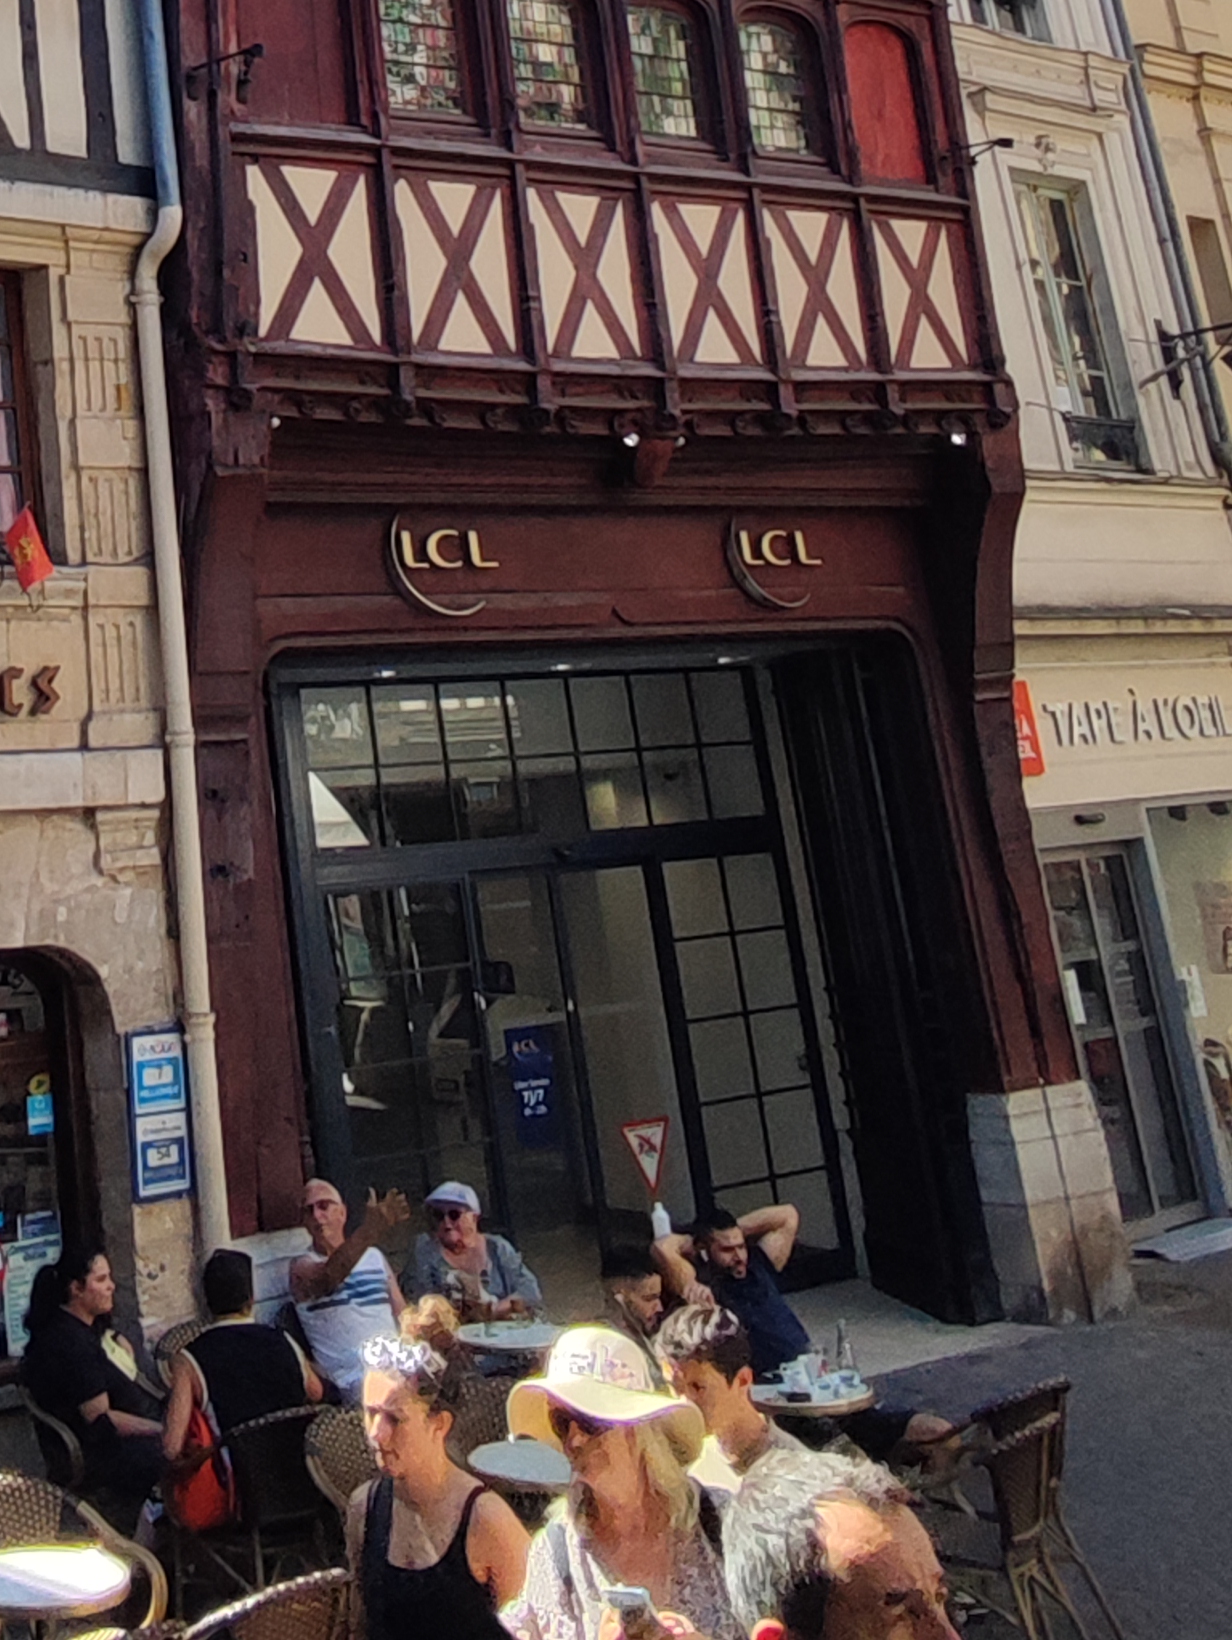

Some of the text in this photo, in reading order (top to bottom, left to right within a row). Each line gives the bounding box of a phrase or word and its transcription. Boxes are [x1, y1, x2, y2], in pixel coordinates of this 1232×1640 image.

[400, 528, 500, 569] LCL
[739, 529, 823, 566] LCL
[1041, 700, 1125, 747] TAPE
